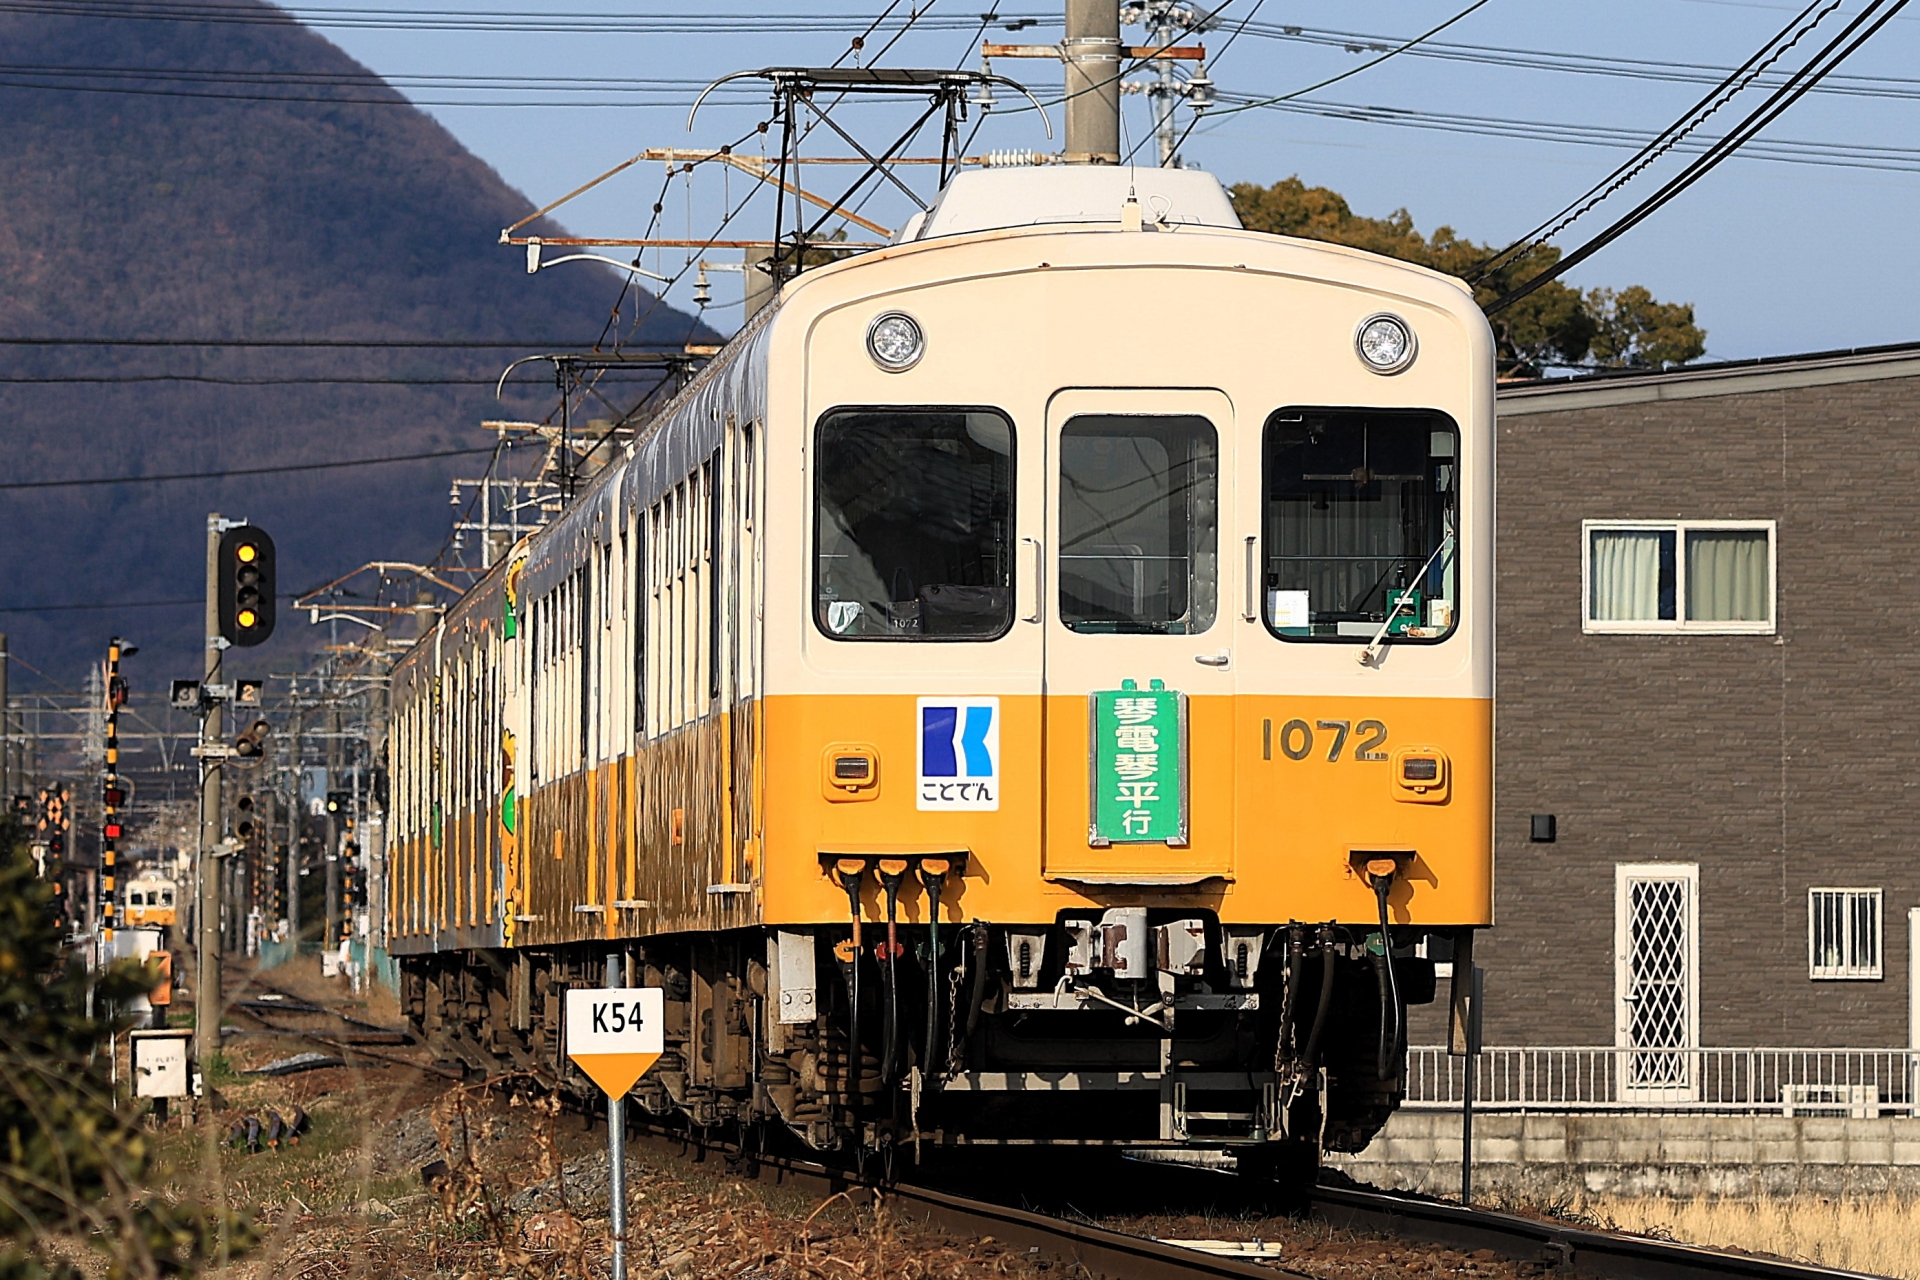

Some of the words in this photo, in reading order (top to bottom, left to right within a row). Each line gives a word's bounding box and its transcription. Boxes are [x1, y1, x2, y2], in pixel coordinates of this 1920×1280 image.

[893, 619, 919, 628] 1072
[241, 684, 256, 702] 2
[1263, 718, 1389, 763] 1072
[1113, 697, 1161, 836] 琴電琴平行
[922, 782, 994, 801] ことでん
[592, 1001, 644, 1034] K54
